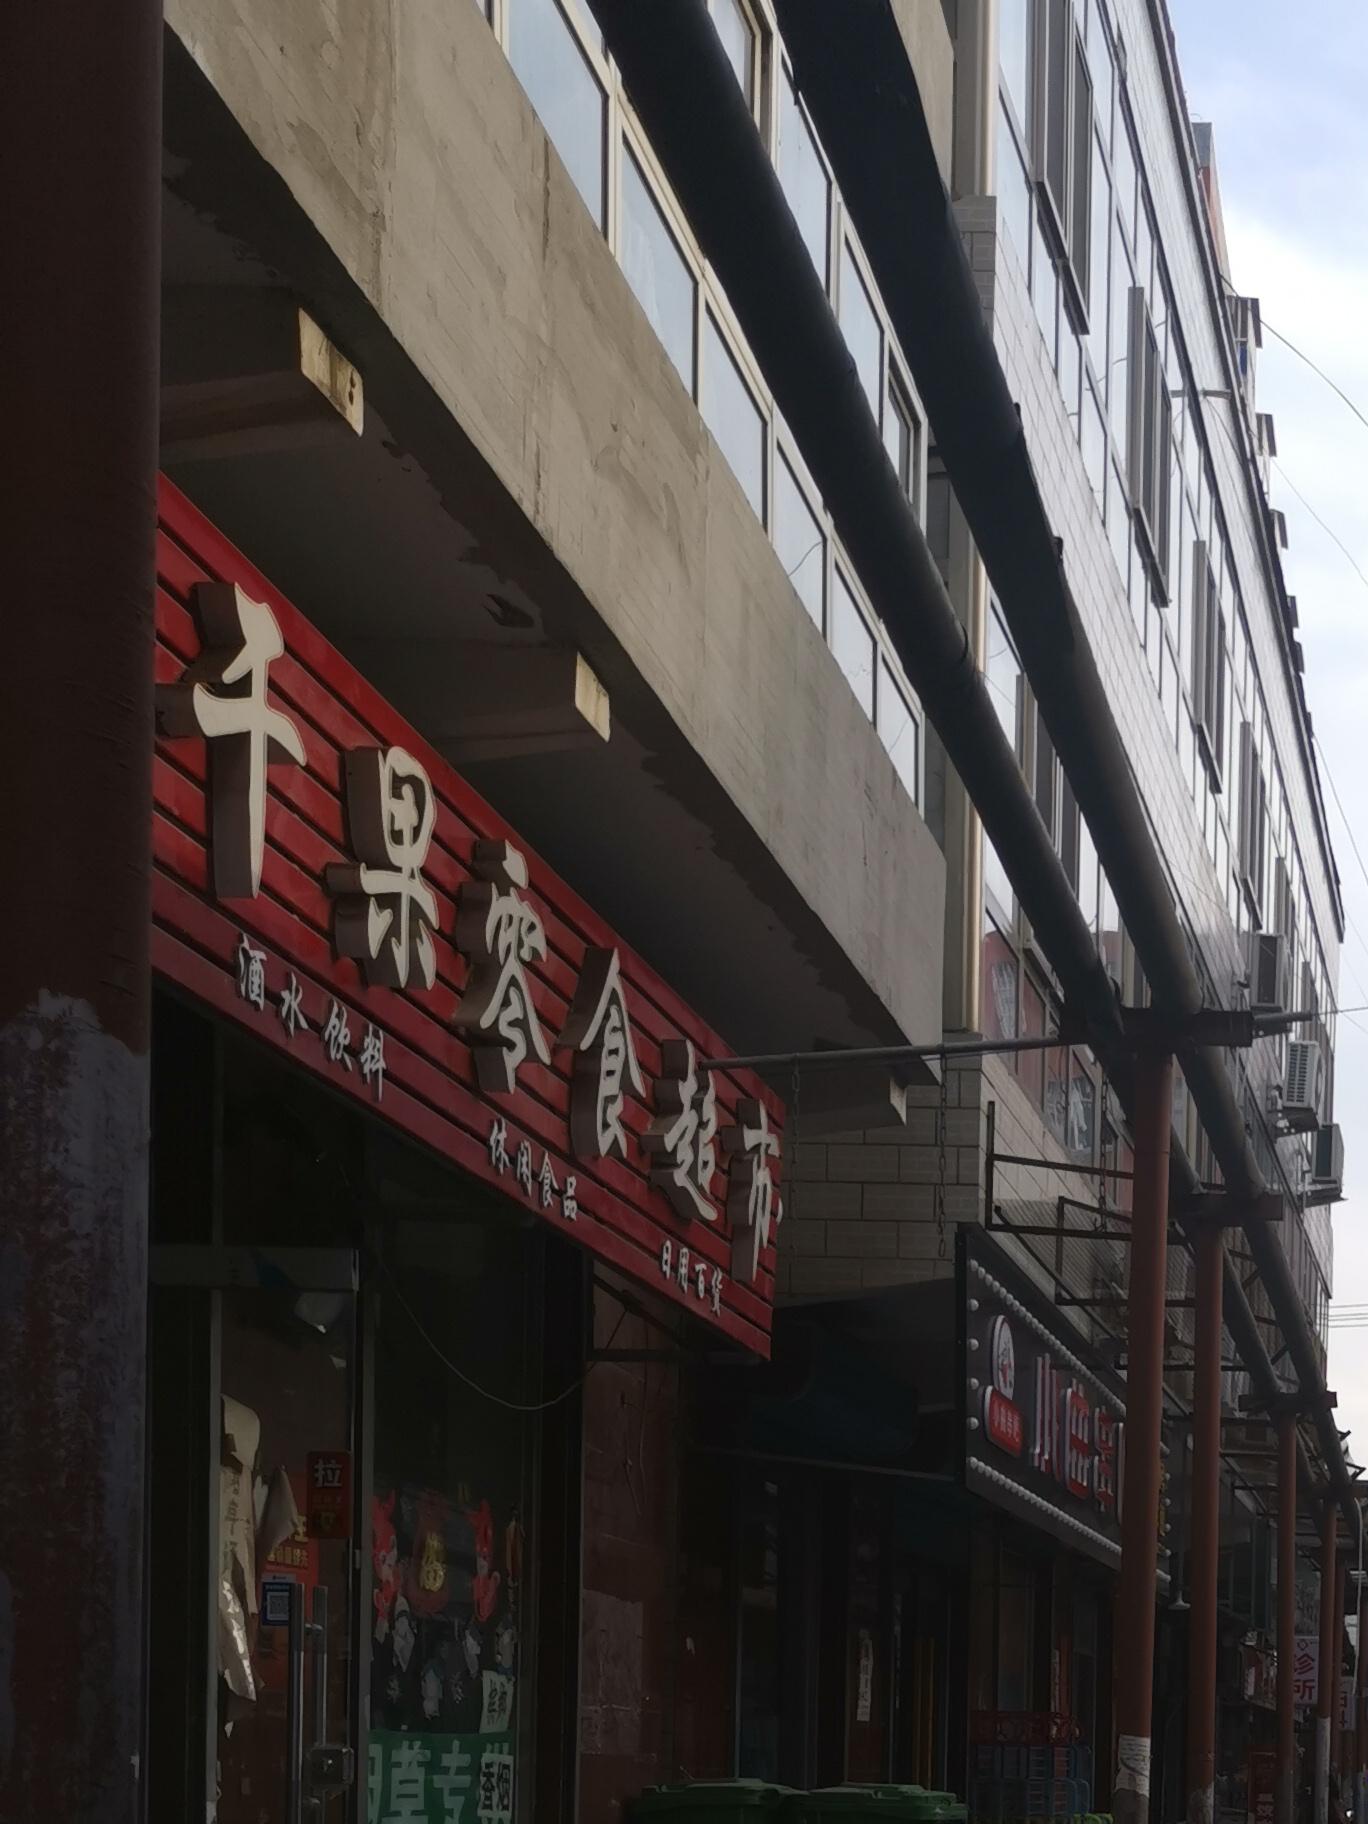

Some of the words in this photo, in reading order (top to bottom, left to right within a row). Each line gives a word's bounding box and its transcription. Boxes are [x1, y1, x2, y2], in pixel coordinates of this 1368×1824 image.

[238, 932, 387, 1102] 酒水饮料
[489, 1117, 578, 1221] 休闲食品
[661, 1239, 723, 1317] 日用百货
[313, 1458, 343, 1488] 拉
